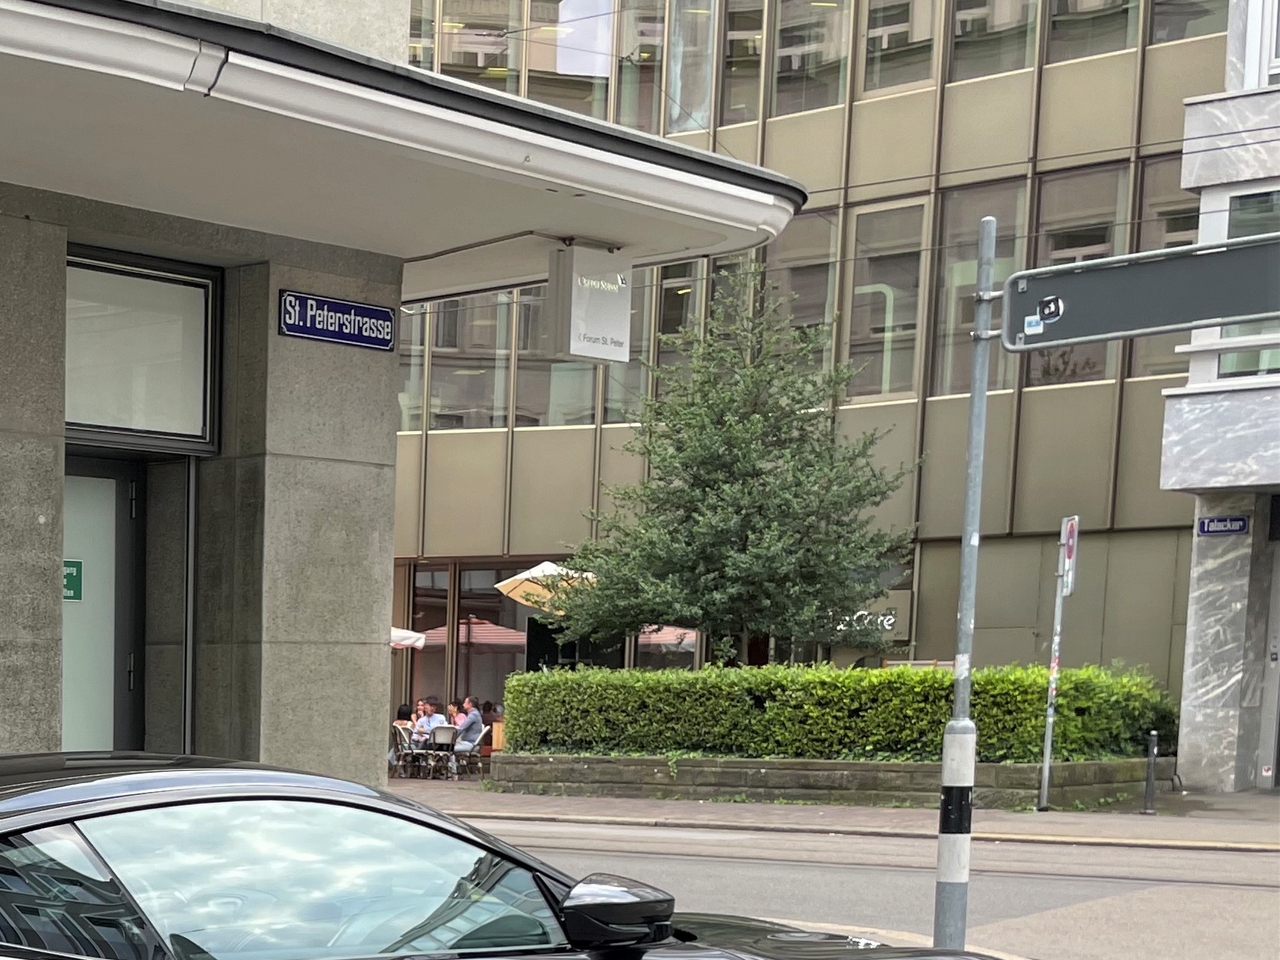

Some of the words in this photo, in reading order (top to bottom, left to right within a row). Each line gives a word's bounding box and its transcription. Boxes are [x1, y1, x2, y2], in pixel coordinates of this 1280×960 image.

[285, 295, 303, 326] St.
[306, 299, 392, 340] Peterstrasse
[582, 333, 601, 345] Forum
[610, 337, 624, 348] Peter
[1203, 518, 1243, 532] Talacker
